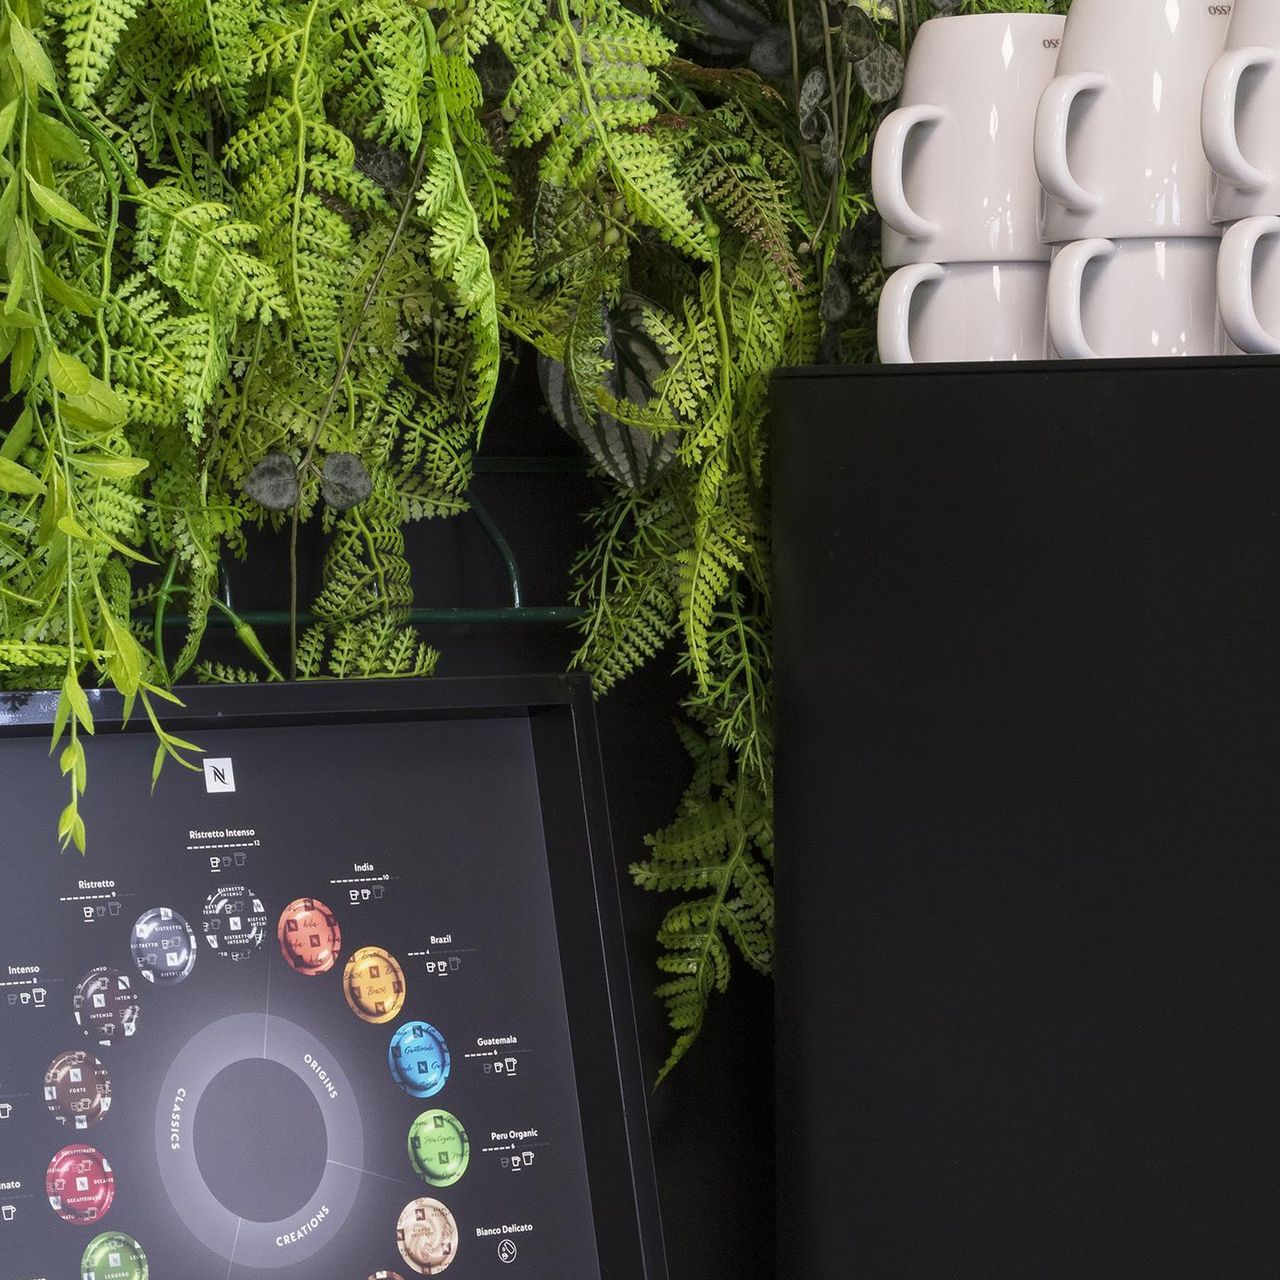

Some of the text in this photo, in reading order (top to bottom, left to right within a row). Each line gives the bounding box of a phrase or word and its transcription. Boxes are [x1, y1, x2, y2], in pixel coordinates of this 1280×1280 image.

[189, 828, 255, 839] Ristretto Intenso
[354, 863, 374, 872] India
[78, 879, 115, 890] Ristretto
[430, 934, 452, 944] Brazil
[8, 964, 40, 975] Intenso
[477, 1035, 517, 1047] Guatemala
[303, 1054, 338, 1099] ORIGINS
[170, 1088, 186, 1150] CLASSICS
[491, 1128, 538, 1141] Peru Organic
[276, 1205, 330, 1247] CREATIONS
[476, 1223, 533, 1237] Bianco Delicato
